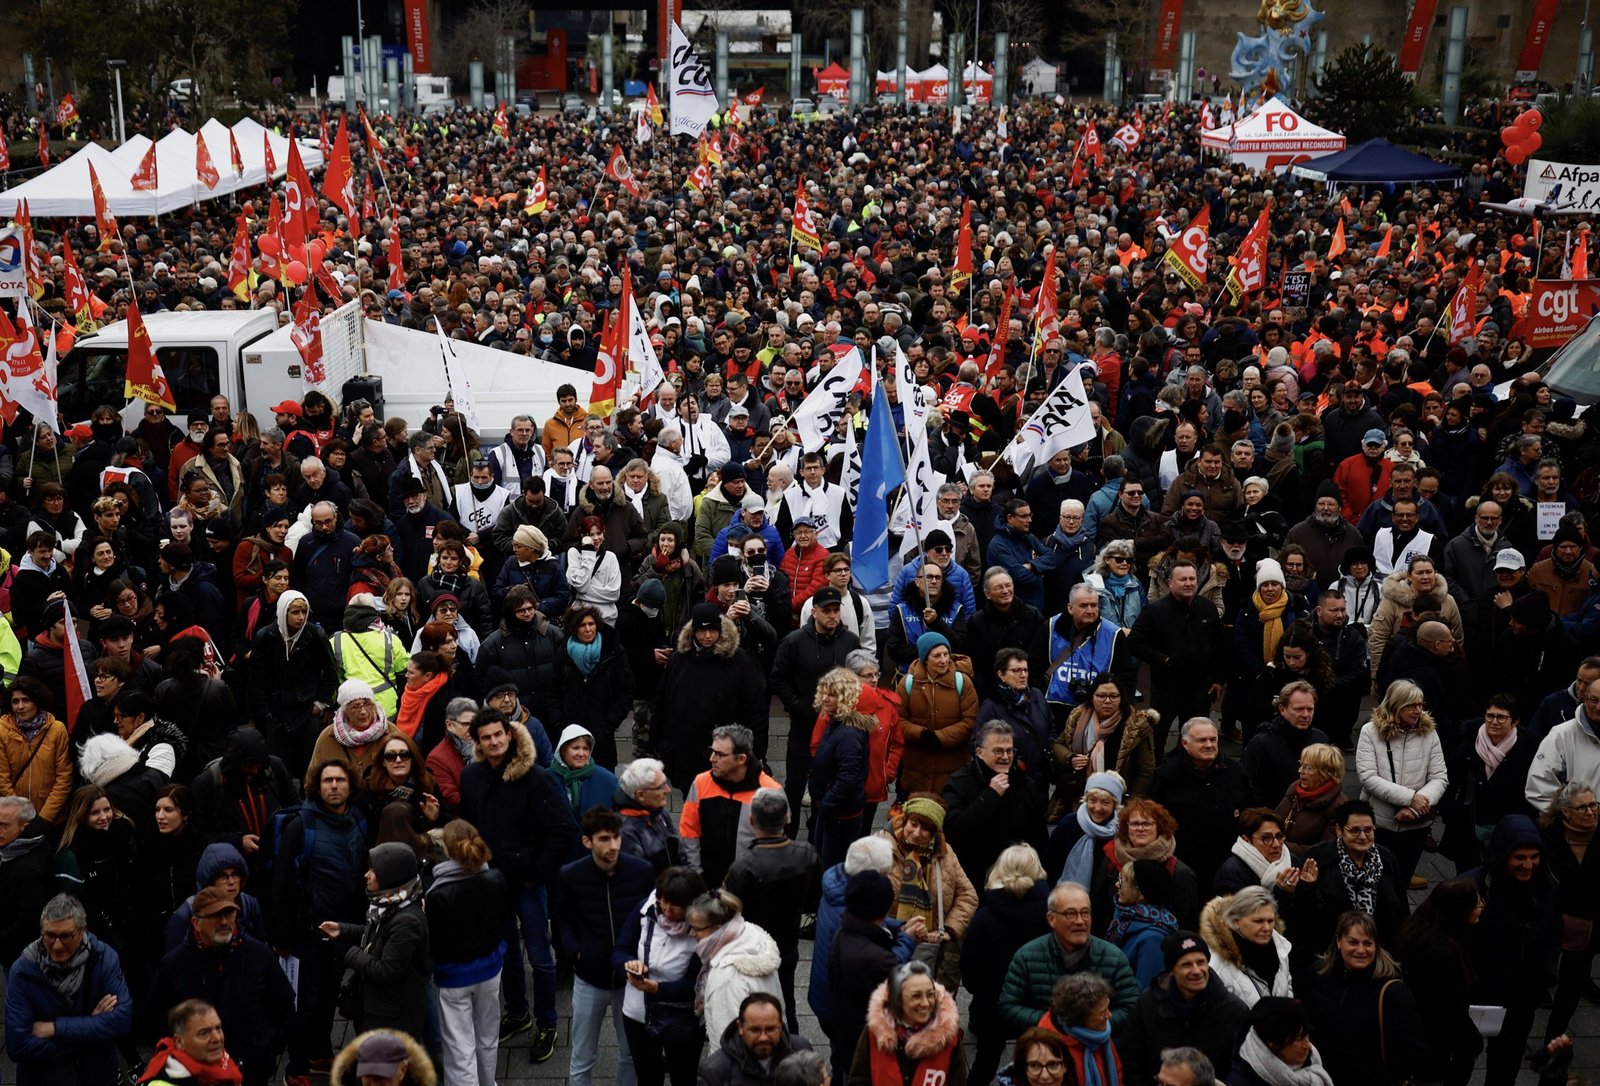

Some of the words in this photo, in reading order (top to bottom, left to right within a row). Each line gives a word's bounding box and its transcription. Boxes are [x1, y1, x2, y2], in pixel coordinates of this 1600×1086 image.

[1265, 111, 1299, 133] FO
[1261, 141, 1302, 151] REVENDIQUER
[1302, 139, 1344, 151] RECONQUÉRIR
[1558, 167, 1600, 187] Afpa
[1538, 282, 1579, 323] cgt
[1534, 326, 1554, 334] Airbus
[1554, 324, 1578, 333] Atlantic
